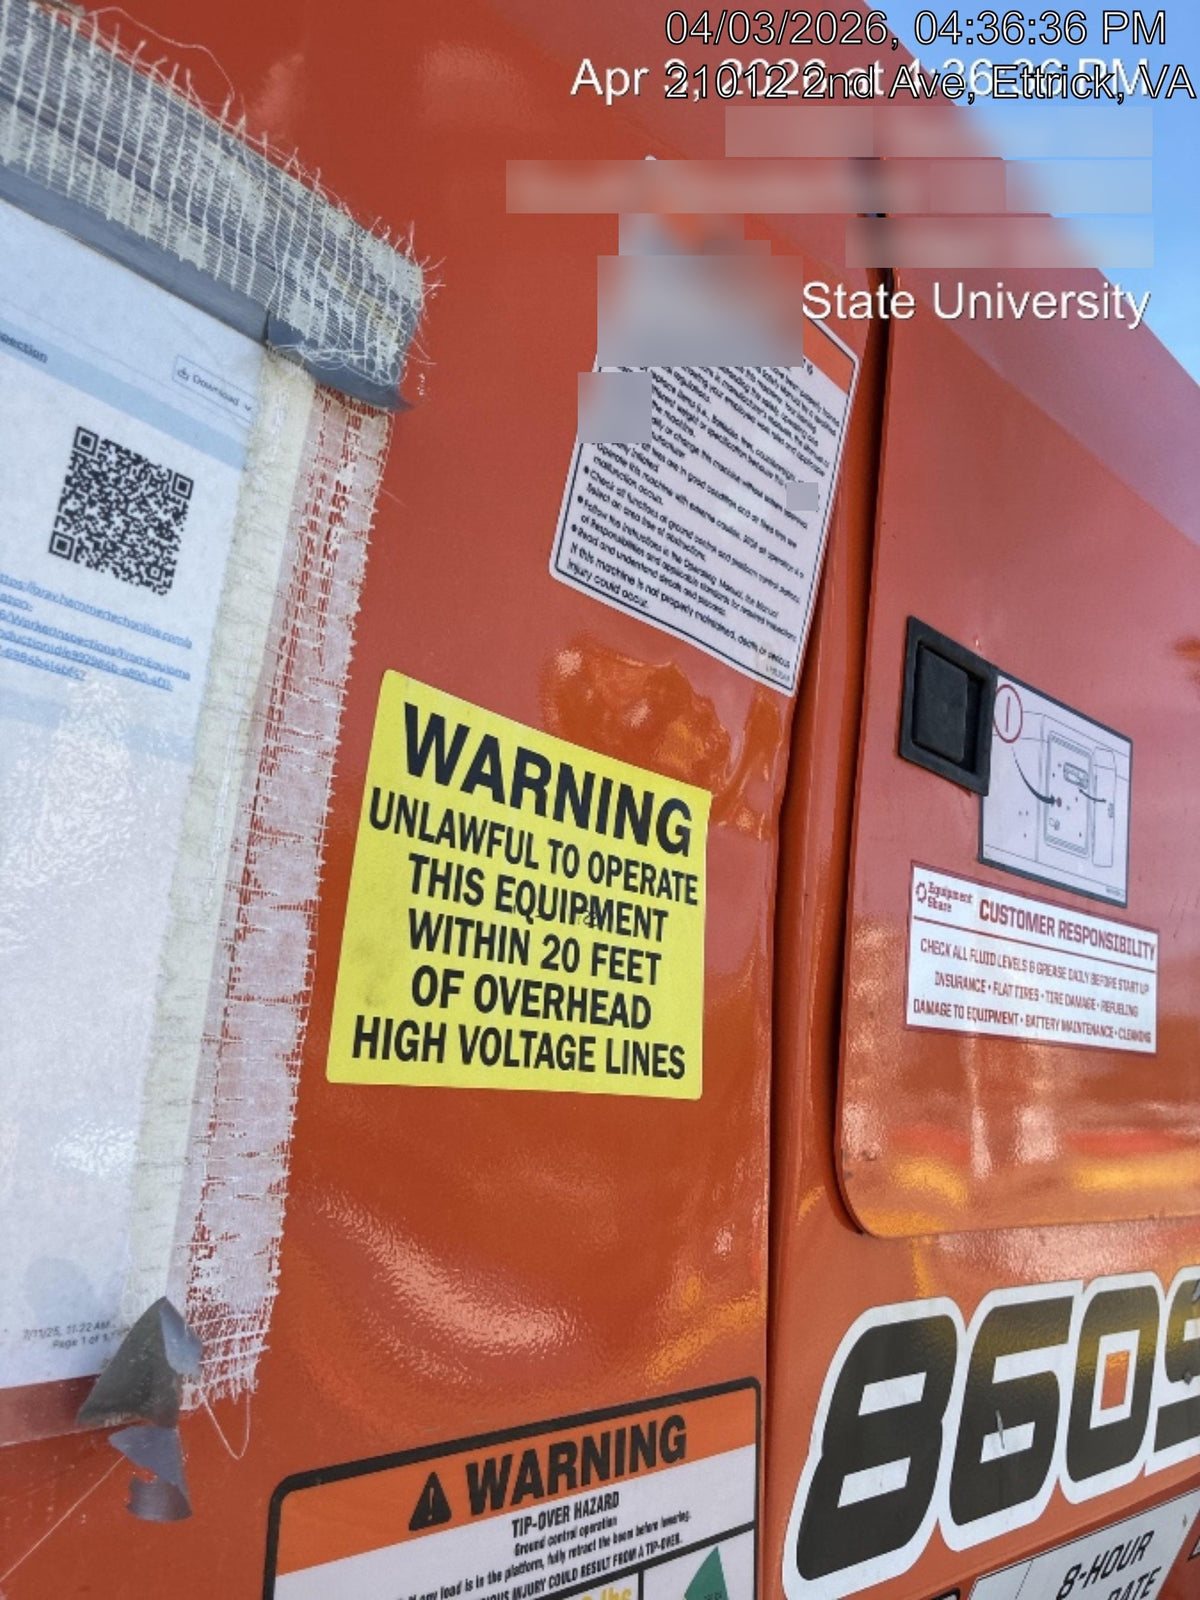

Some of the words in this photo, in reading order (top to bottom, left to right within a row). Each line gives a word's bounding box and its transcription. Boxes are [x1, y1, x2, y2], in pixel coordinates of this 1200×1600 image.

[193, 374, 239, 406] Download
[403, 701, 692, 857] WARNING
[369, 787, 539, 870] UNLAWFUL
[548, 838, 580, 879] TO
[588, 851, 698, 906] OPERATE
[408, 853, 485, 907] THIS
[495, 876, 668, 942] EQUIPMENT
[928, 882, 973, 903] Equipment
[928, 896, 952, 912] Share
[408, 908, 530, 966] WITHIN
[541, 933, 580, 973] 20
[591, 942, 662, 985] FEET
[980, 899, 1055, 937] CUSTOMER
[1058, 919, 1156, 960] RESPONSIBILITY
[411, 965, 465, 1009] OF
[474, 973, 651, 1030] OVERHEAD
[921, 938, 951, 957] CHECK
[953, 945, 968, 961] ALL
[969, 949, 996, 966] FLUID
[997, 954, 1028, 973] LEVELS
[1037, 962, 1066, 980] GREASE
[1068, 969, 1089, 984] DAILY
[1090, 973, 1117, 990] BEFORE
[1118, 978, 1139, 993] START
[1139, 983, 1149, 995] UP
[935, 970, 986, 993] INSURANCE
[993, 981, 1013, 997] FLAT
[1015, 985, 1039, 1001] TIRES
[1045, 990, 1064, 1005] TIRE
[1065, 993, 1096, 1011] DAMAGE
[1101, 1000, 1138, 1017] REFUELING
[352, 1015, 447, 1064] HIGH
[459, 1024, 596, 1072] VOLTAGE
[605, 1038, 686, 1080] LINES
[913, 998, 952, 1017] DAMAGE
[953, 1004, 964, 1019] TO
[967, 1006, 1019, 1024] EQUIPMENT
[1026, 1014, 1059, 1031] BATTERY
[1061, 1019, 1114, 1039] MAINTENANCE
[1118, 1027, 1151, 1043] CLEANING
[465, 1414, 688, 1517] WARNING
[512, 1507, 570, 1538] TIP-OVER
[574, 1491, 619, 1521] HAZARD
[515, 1536, 545, 1556] Ground
[547, 1526, 577, 1546] control
[579, 1515, 618, 1538] operation
[440, 1580, 462, 1600] load
[465, 1578, 474, 1592] is
[476, 1575, 484, 1589] in
[487, 1570, 502, 1585] the
[504, 1558, 544, 1583] platform,
[547, 1549, 566, 1565] fully
[569, 1542, 596, 1559] retract
[599, 1537, 610, 1550] the
[613, 1529, 633, 1544] boom
[635, 1521, 658, 1539] before
[661, 1510, 692, 1529] lowering.
[512, 1577, 546, 1600] INJURY
[549, 1569, 578, 1589] COULD
[581, 1558, 610, 1578] RESULT
[613, 1549, 637, 1567] FROM
[638, 1547, 644, 1558] A
[646, 1532, 683, 1556] TIP-OVER.
[1056, 1530, 1155, 1600] 8-HOUR
